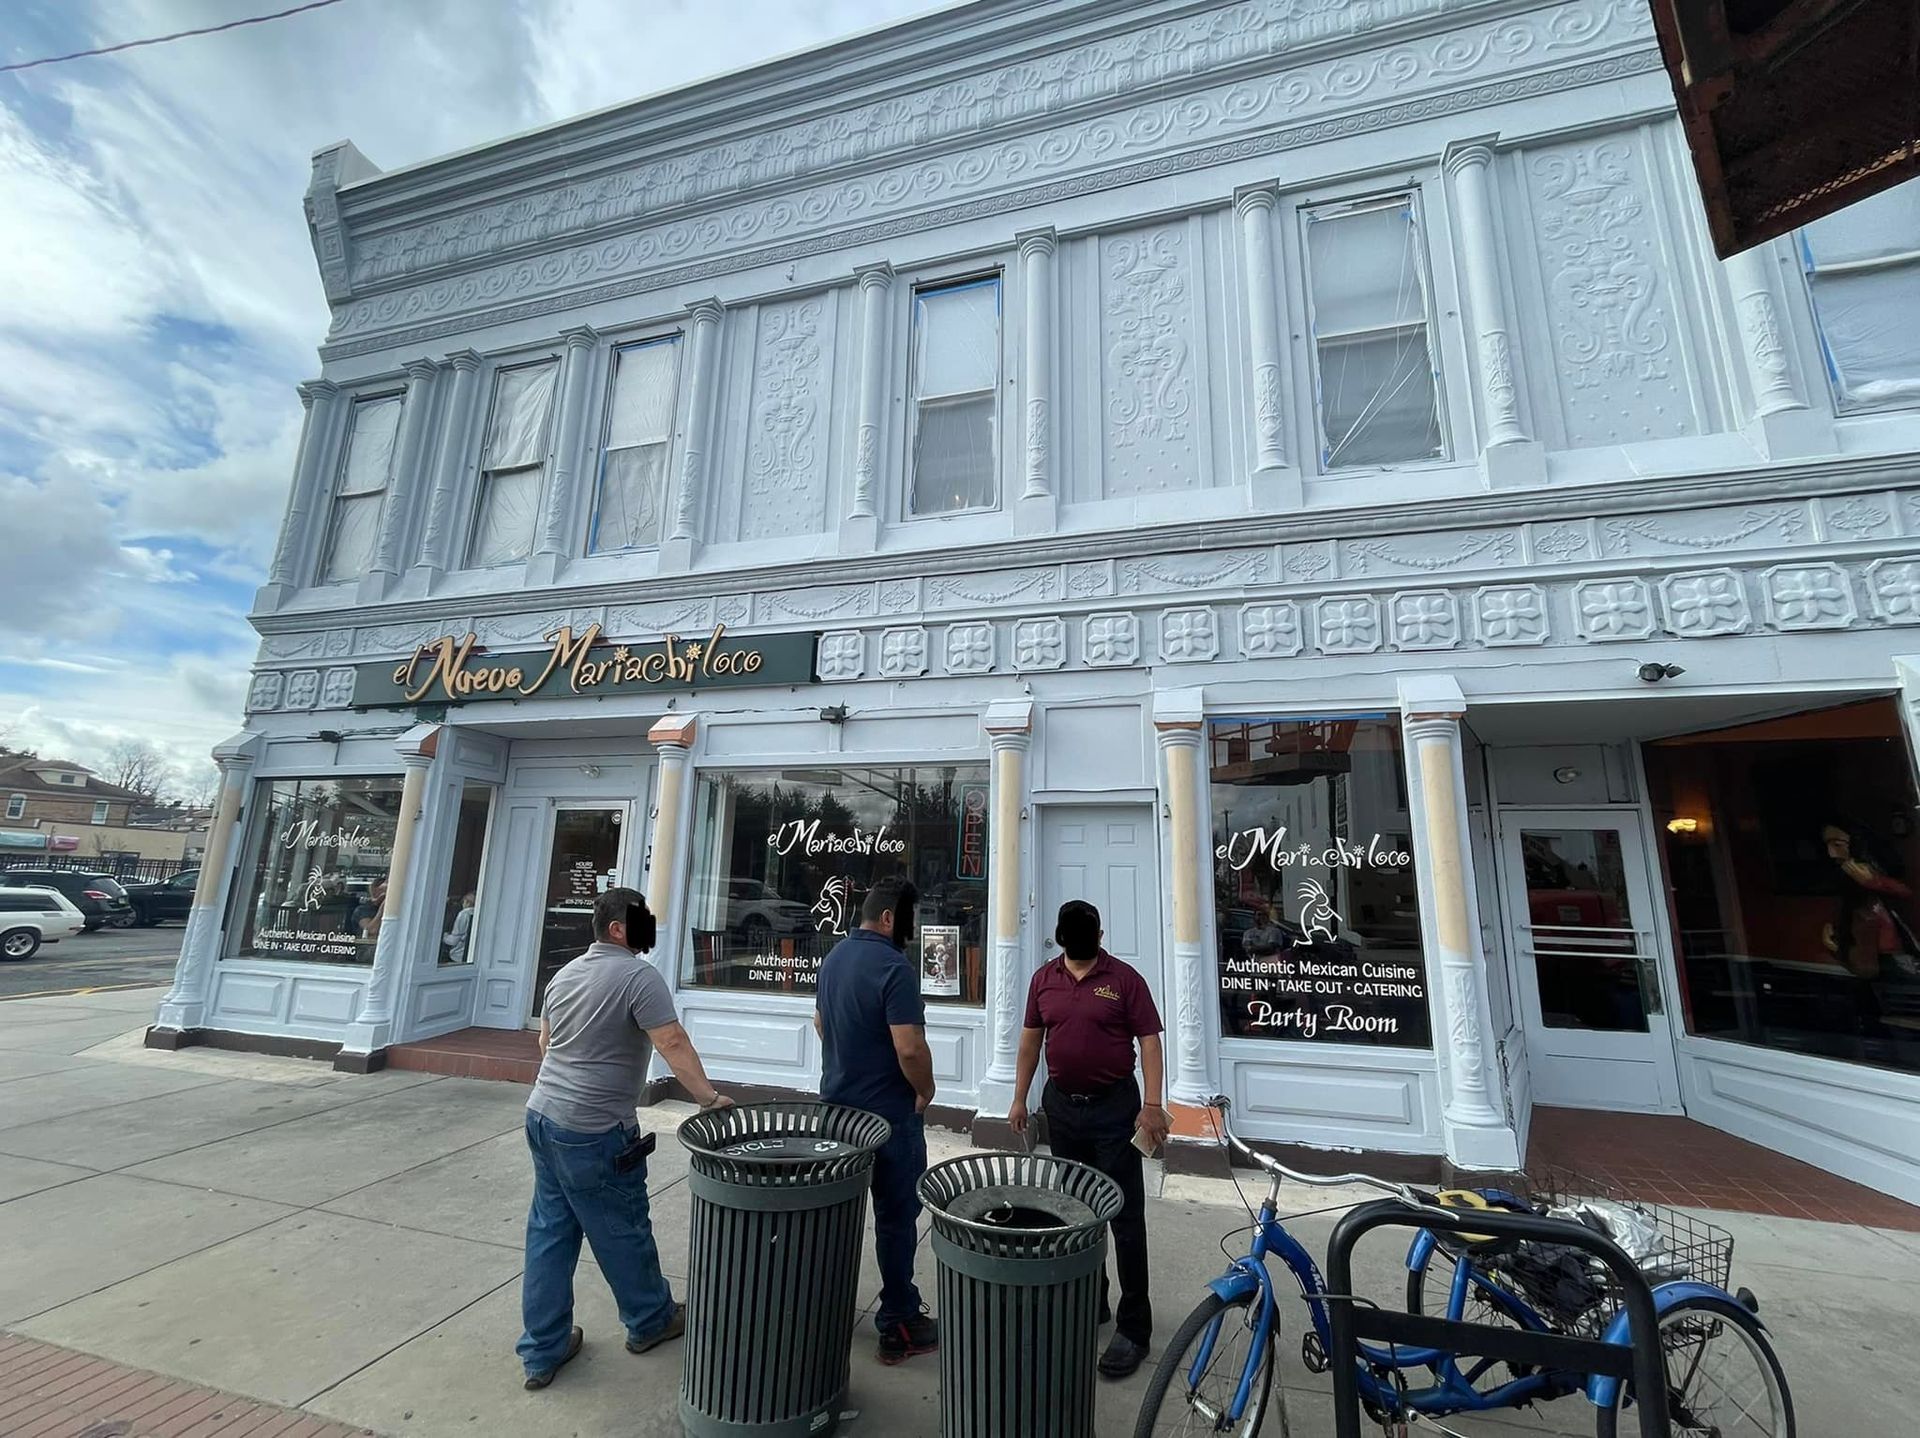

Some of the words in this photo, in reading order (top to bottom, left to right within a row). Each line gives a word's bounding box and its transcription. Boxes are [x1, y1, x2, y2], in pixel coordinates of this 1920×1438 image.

[393, 645, 425, 688] el
[405, 633, 523, 700] Nuevo
[280, 823, 296, 843] el
[767, 824, 786, 848] el
[962, 790, 985, 875] OPEN
[1215, 832, 1239, 862] el
[258, 928, 295, 940] Authentic
[296, 930, 326, 941] Mexican
[328, 932, 356, 943] Cuisine
[282, 943, 300, 952] TAKE
[301, 944, 316, 952] OUT
[321, 945, 356, 955] CATERING
[754, 953, 809, 969] Authentic
[1226, 958, 1295, 975] Authentic
[1299, 961, 1358, 977] Mexican
[1362, 963, 1416, 979] Cuisine
[749, 969, 773, 981] DINE
[775, 971, 786, 981] IN
[1222, 977, 1252, 990] DINE
[1255, 978, 1269, 991] IN
[1278, 979, 1312, 993] TAKE
[1315, 980, 1343, 994] OUT
[1354, 982, 1423, 998] CATERING
[1247, 1001, 1317, 1038] Party
[1325, 1004, 1399, 1033] Room
[726, 1139, 784, 1156] CYCLE
